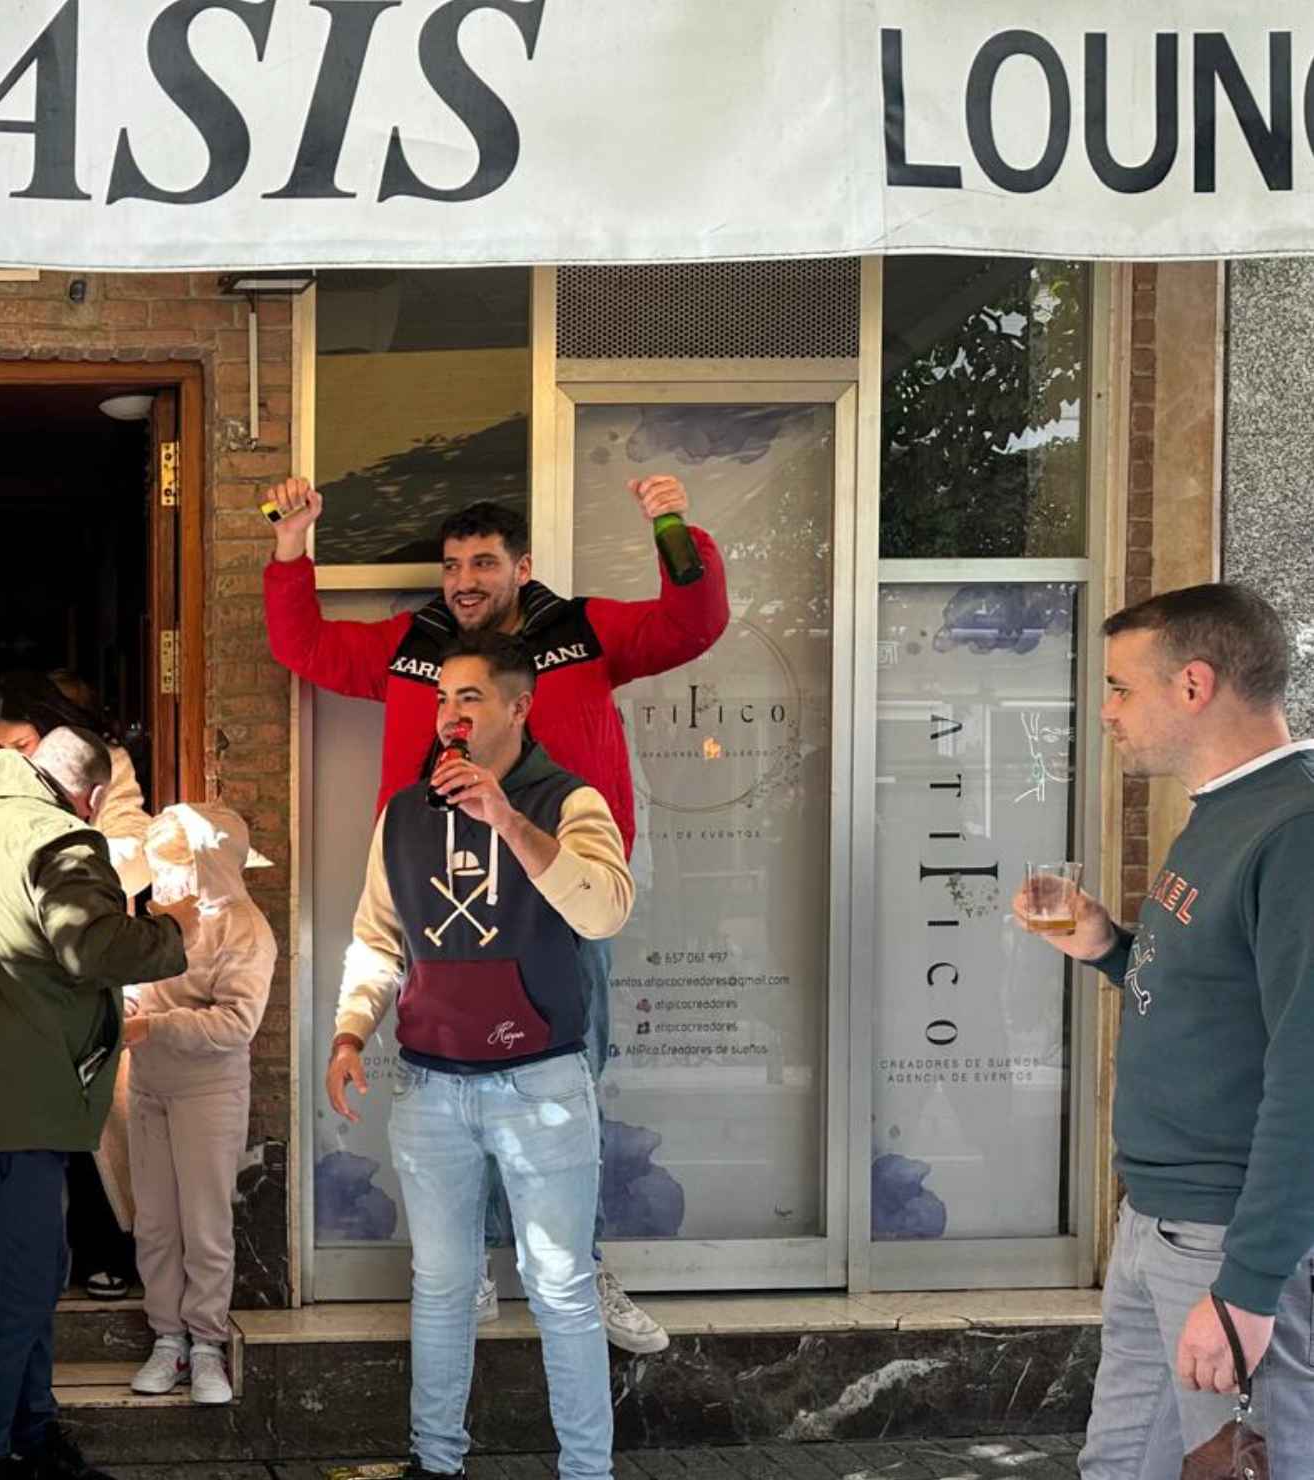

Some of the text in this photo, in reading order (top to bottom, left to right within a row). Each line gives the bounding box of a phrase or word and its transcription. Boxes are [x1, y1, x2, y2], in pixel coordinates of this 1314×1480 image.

[880, 27, 1314, 195] LOUN
[879, 1058, 959, 1069] CREADORES
[965, 1058, 982, 1068] DE
[888, 1071, 1033, 1083] AGENCIA DE EVENTOS
